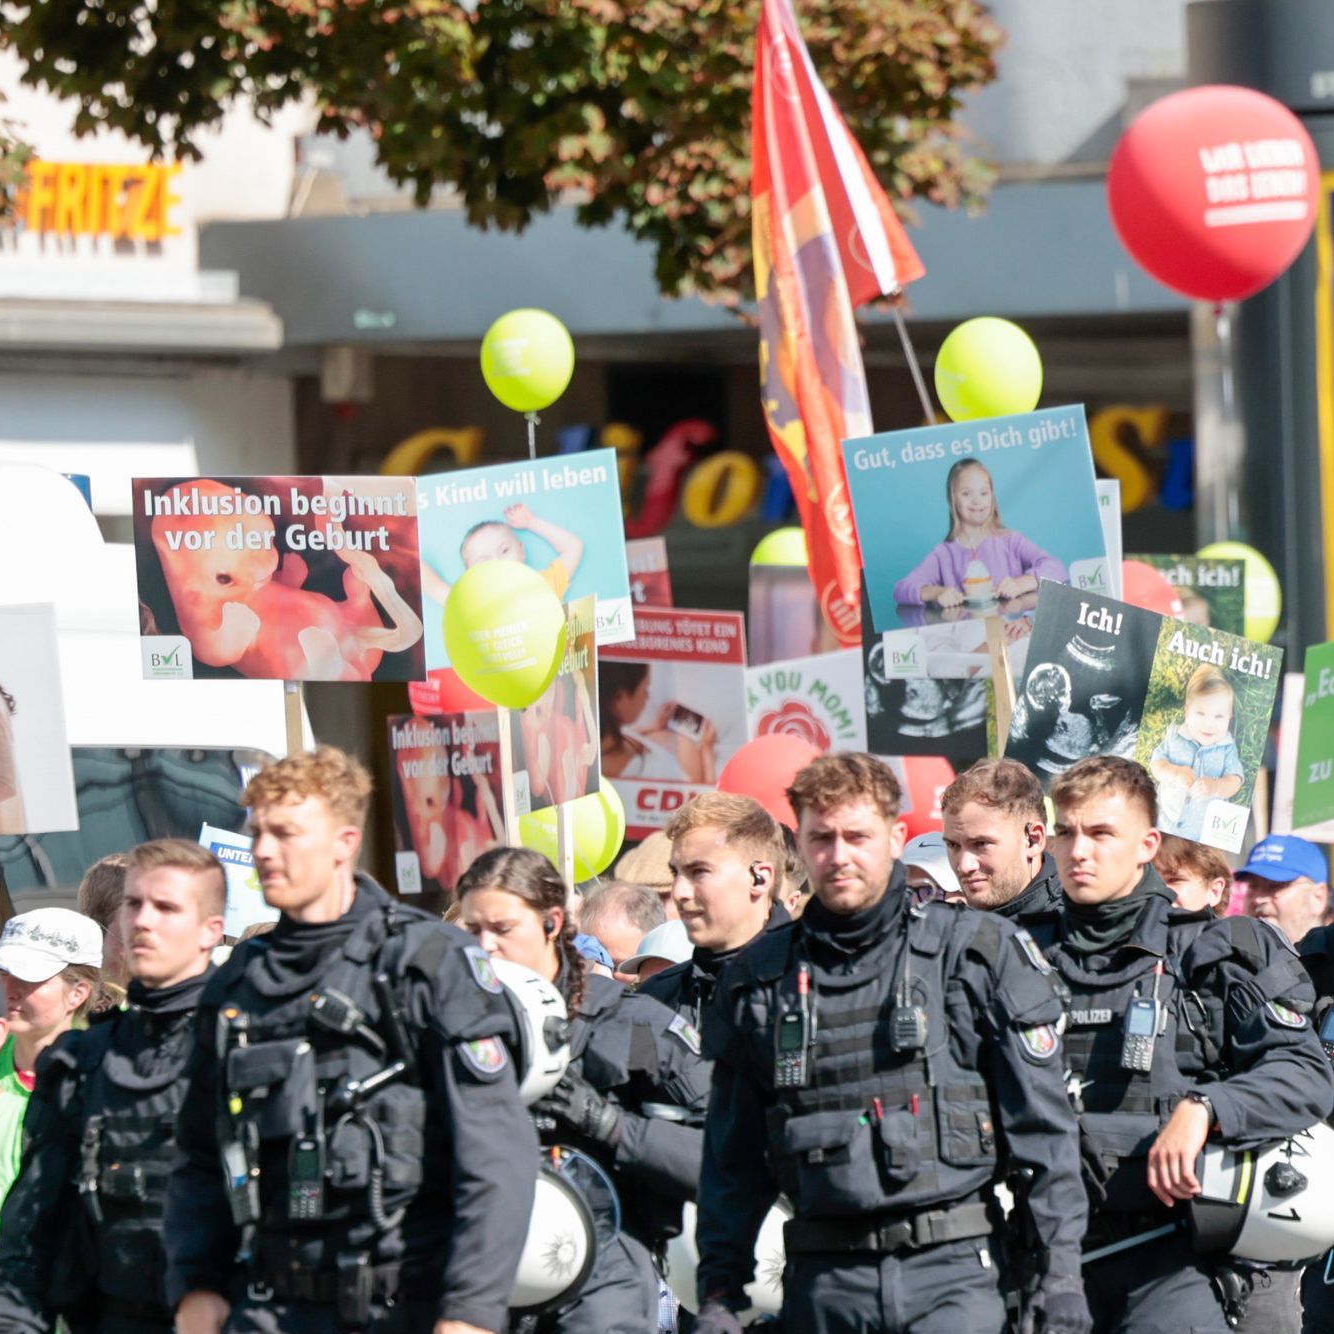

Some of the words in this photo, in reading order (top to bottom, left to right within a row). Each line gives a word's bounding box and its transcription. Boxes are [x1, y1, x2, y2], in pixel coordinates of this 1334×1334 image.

[854, 448, 897, 471] Gut,
[901, 442, 945, 464] dass
[951, 437, 973, 456] es
[977, 426, 1023, 452] Dich
[1028, 416, 1077, 449] gibt!
[435, 477, 488, 507] Kind
[494, 471, 536, 499] will
[542, 464, 607, 492] leben
[144, 488, 281, 517] Inklusion
[291, 488, 408, 522] beginnt
[165, 530, 217, 551] vor
[226, 524, 276, 551] der
[285, 524, 390, 551] Geburt
[1197, 564, 1241, 588] ich!
[1076, 602, 1124, 636] Ich!
[1168, 630, 1225, 667] Auch
[1229, 649, 1273, 680] ich!
[759, 670, 802, 696] YOU
[807, 678, 857, 741] MOM!
[392, 721, 451, 750] Inklusion
[403, 760, 425, 779] vor
[451, 751, 494, 777] Geburt
[1307, 757, 1332, 784] zu
[1071, 1008, 1113, 1024] POLIZEI
